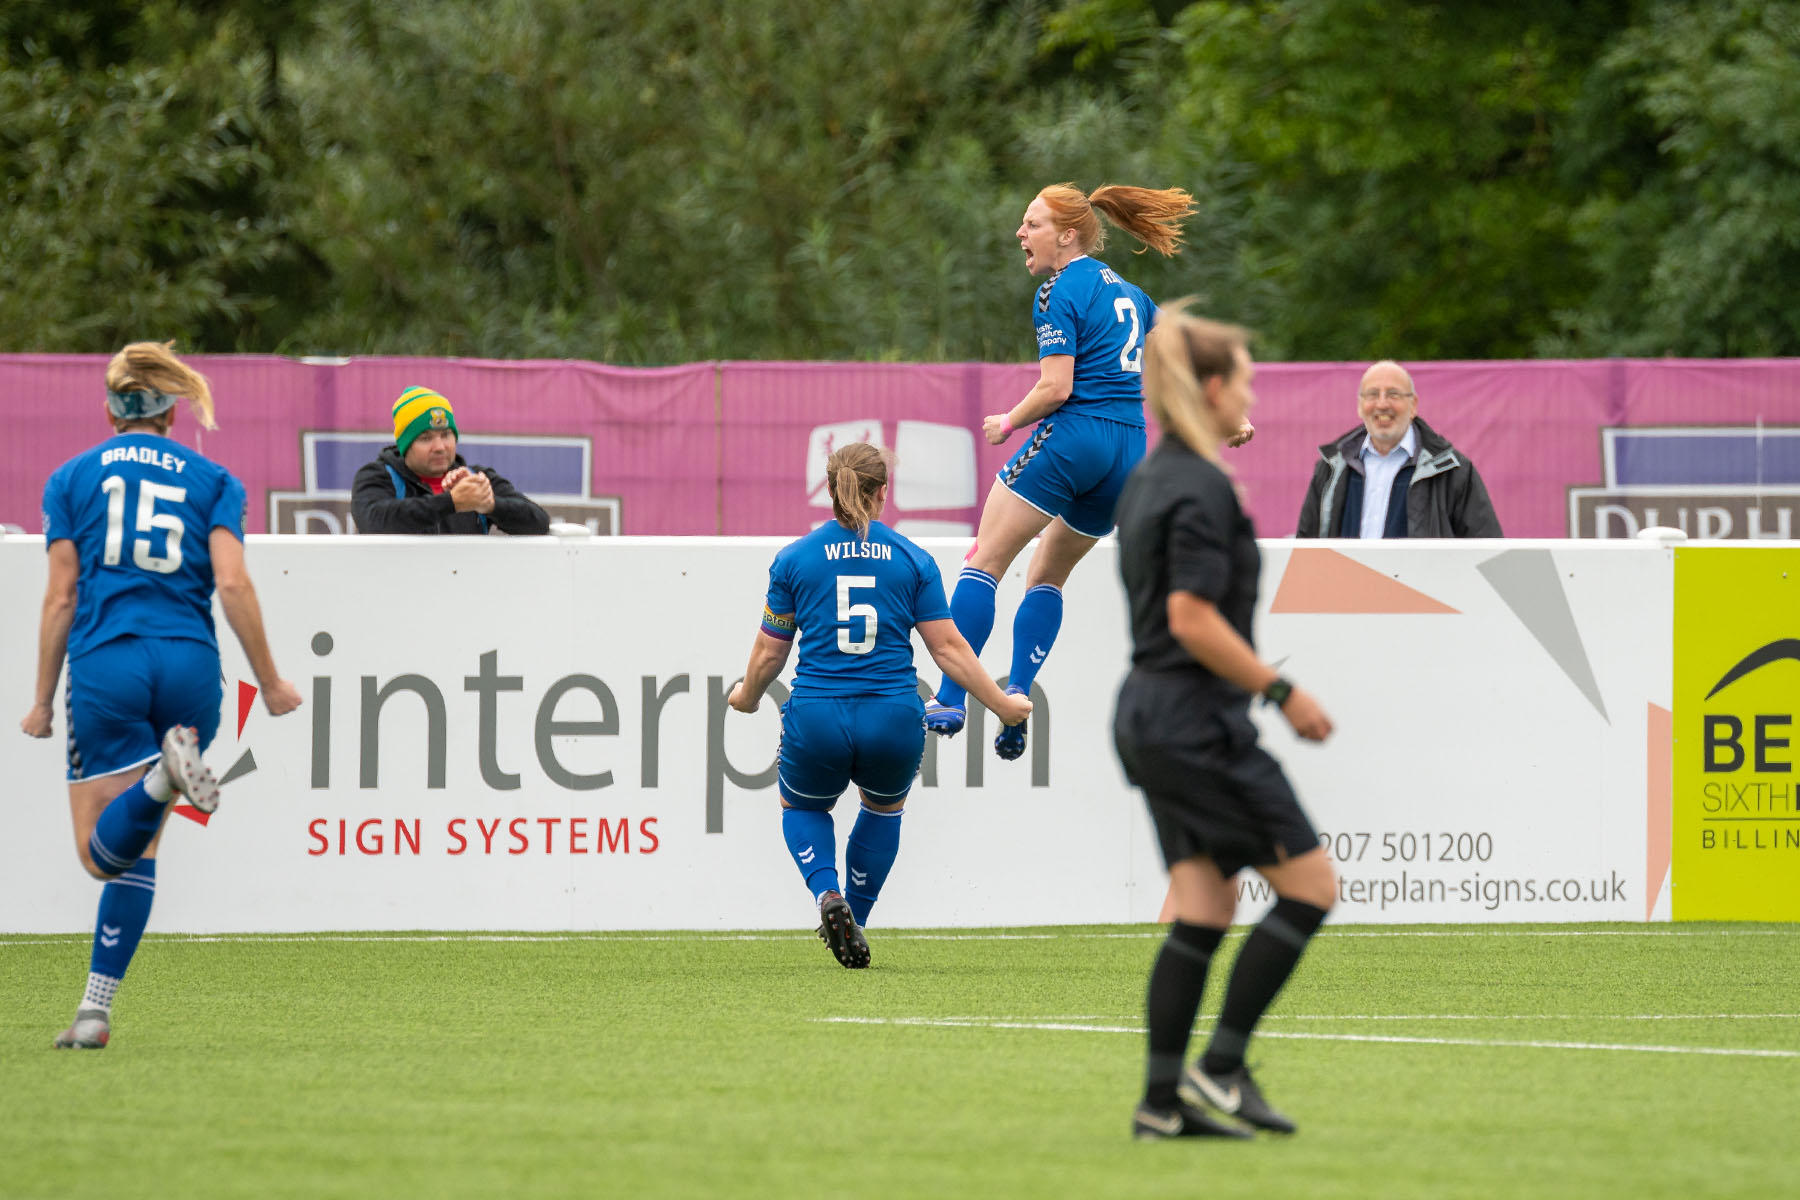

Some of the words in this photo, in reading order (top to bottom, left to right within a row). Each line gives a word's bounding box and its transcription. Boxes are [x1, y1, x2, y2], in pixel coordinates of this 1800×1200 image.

[1114, 298, 1142, 372] 2
[101, 446, 186, 473] BRADLEY
[101, 475, 187, 574] 15
[824, 541, 892, 560] WILSON
[836, 575, 878, 655] 5
[311, 631, 1050, 833] interpn
[1703, 714, 1792, 773] BE
[1702, 782, 1800, 813] SIXTH
[308, 818, 421, 855] SIGN
[446, 817, 660, 855] SYSTEMS
[1381, 832, 1493, 862] 501200
